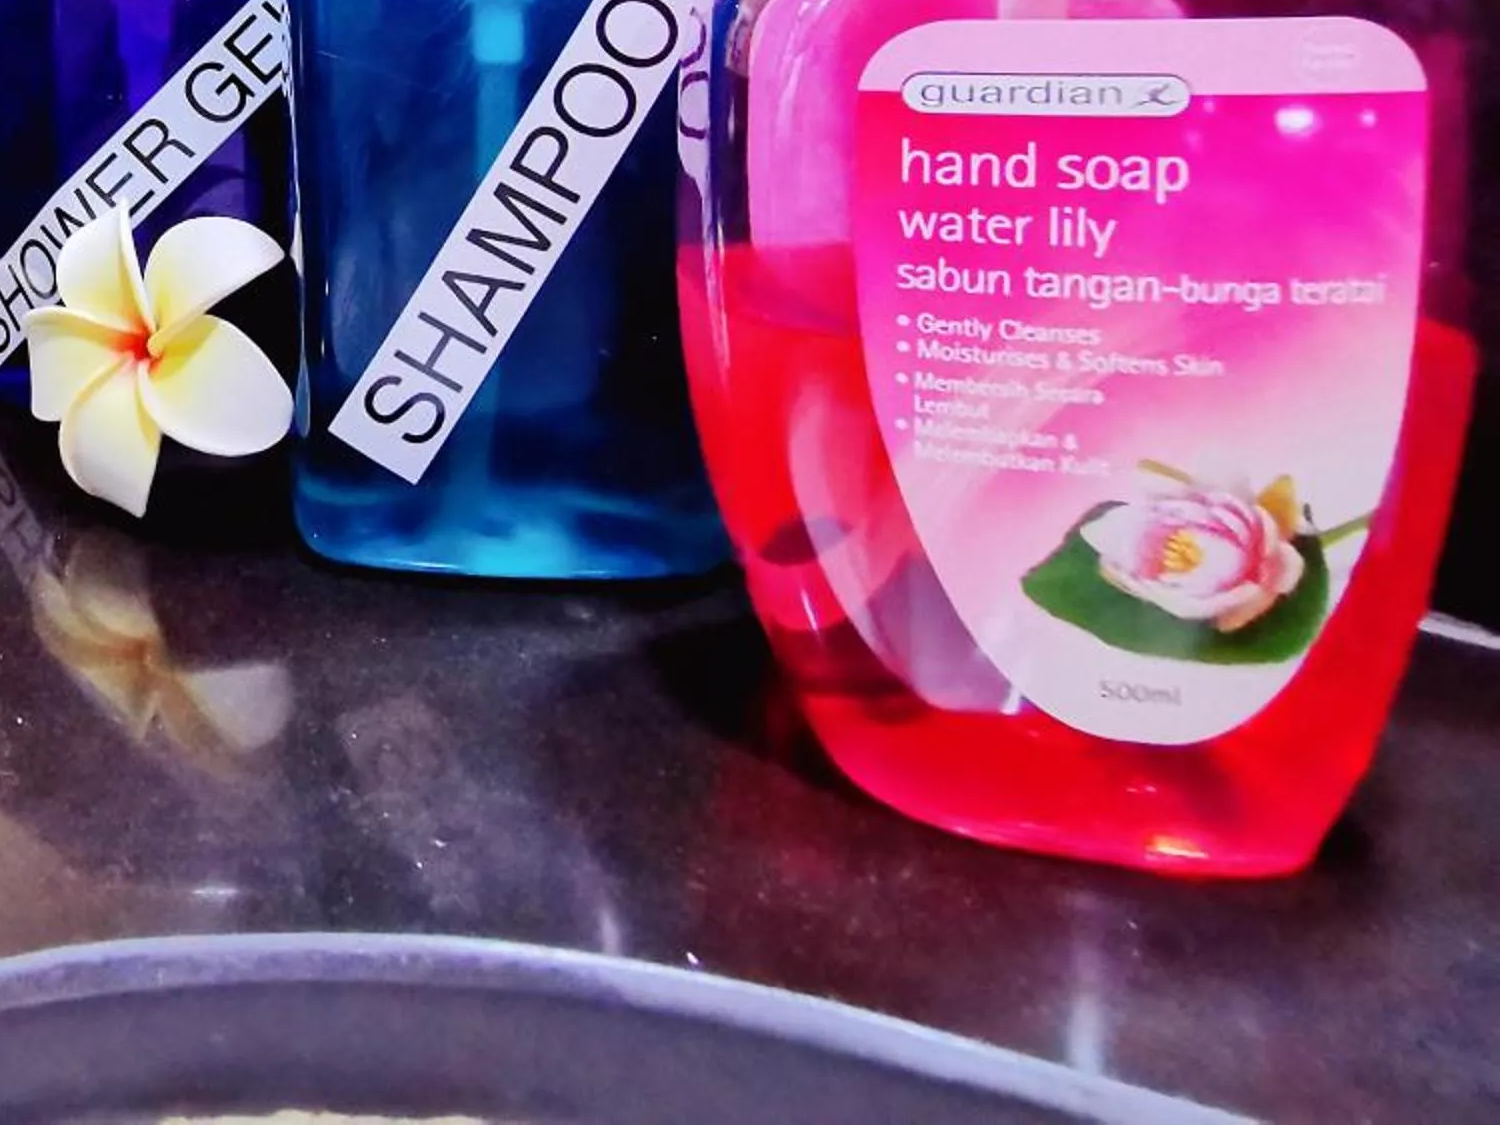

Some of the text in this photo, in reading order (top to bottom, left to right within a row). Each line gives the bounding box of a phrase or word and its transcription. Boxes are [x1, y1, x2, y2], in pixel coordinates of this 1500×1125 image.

[919, 75, 1123, 107] guardian
[900, 137, 1190, 204] hand soap
[898, 206, 1117, 258] water lily
[896, 258, 1011, 296] sabun
[916, 312, 1104, 347] Gently Cleanses
[1100, 679, 1182, 706] 500ml
